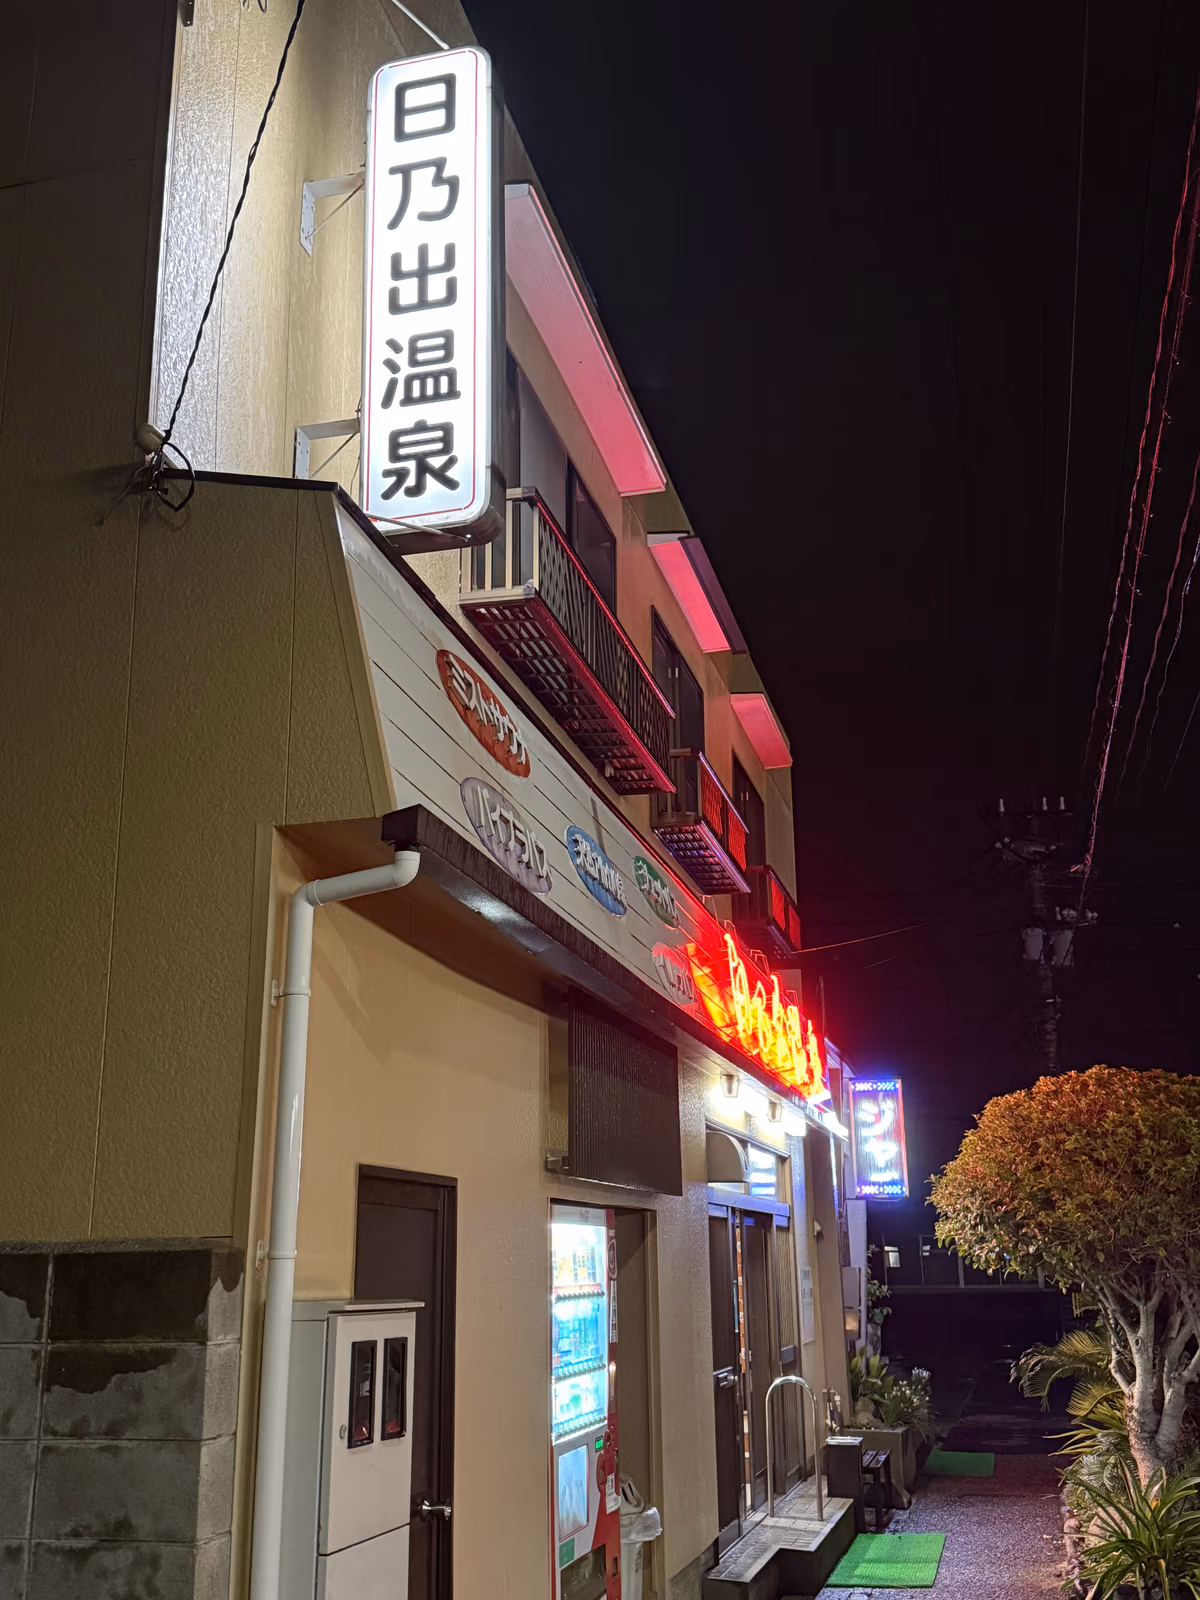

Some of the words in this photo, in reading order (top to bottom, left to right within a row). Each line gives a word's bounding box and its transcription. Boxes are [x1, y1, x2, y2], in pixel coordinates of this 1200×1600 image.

[381, 72, 461, 500] 日乃出温泉
